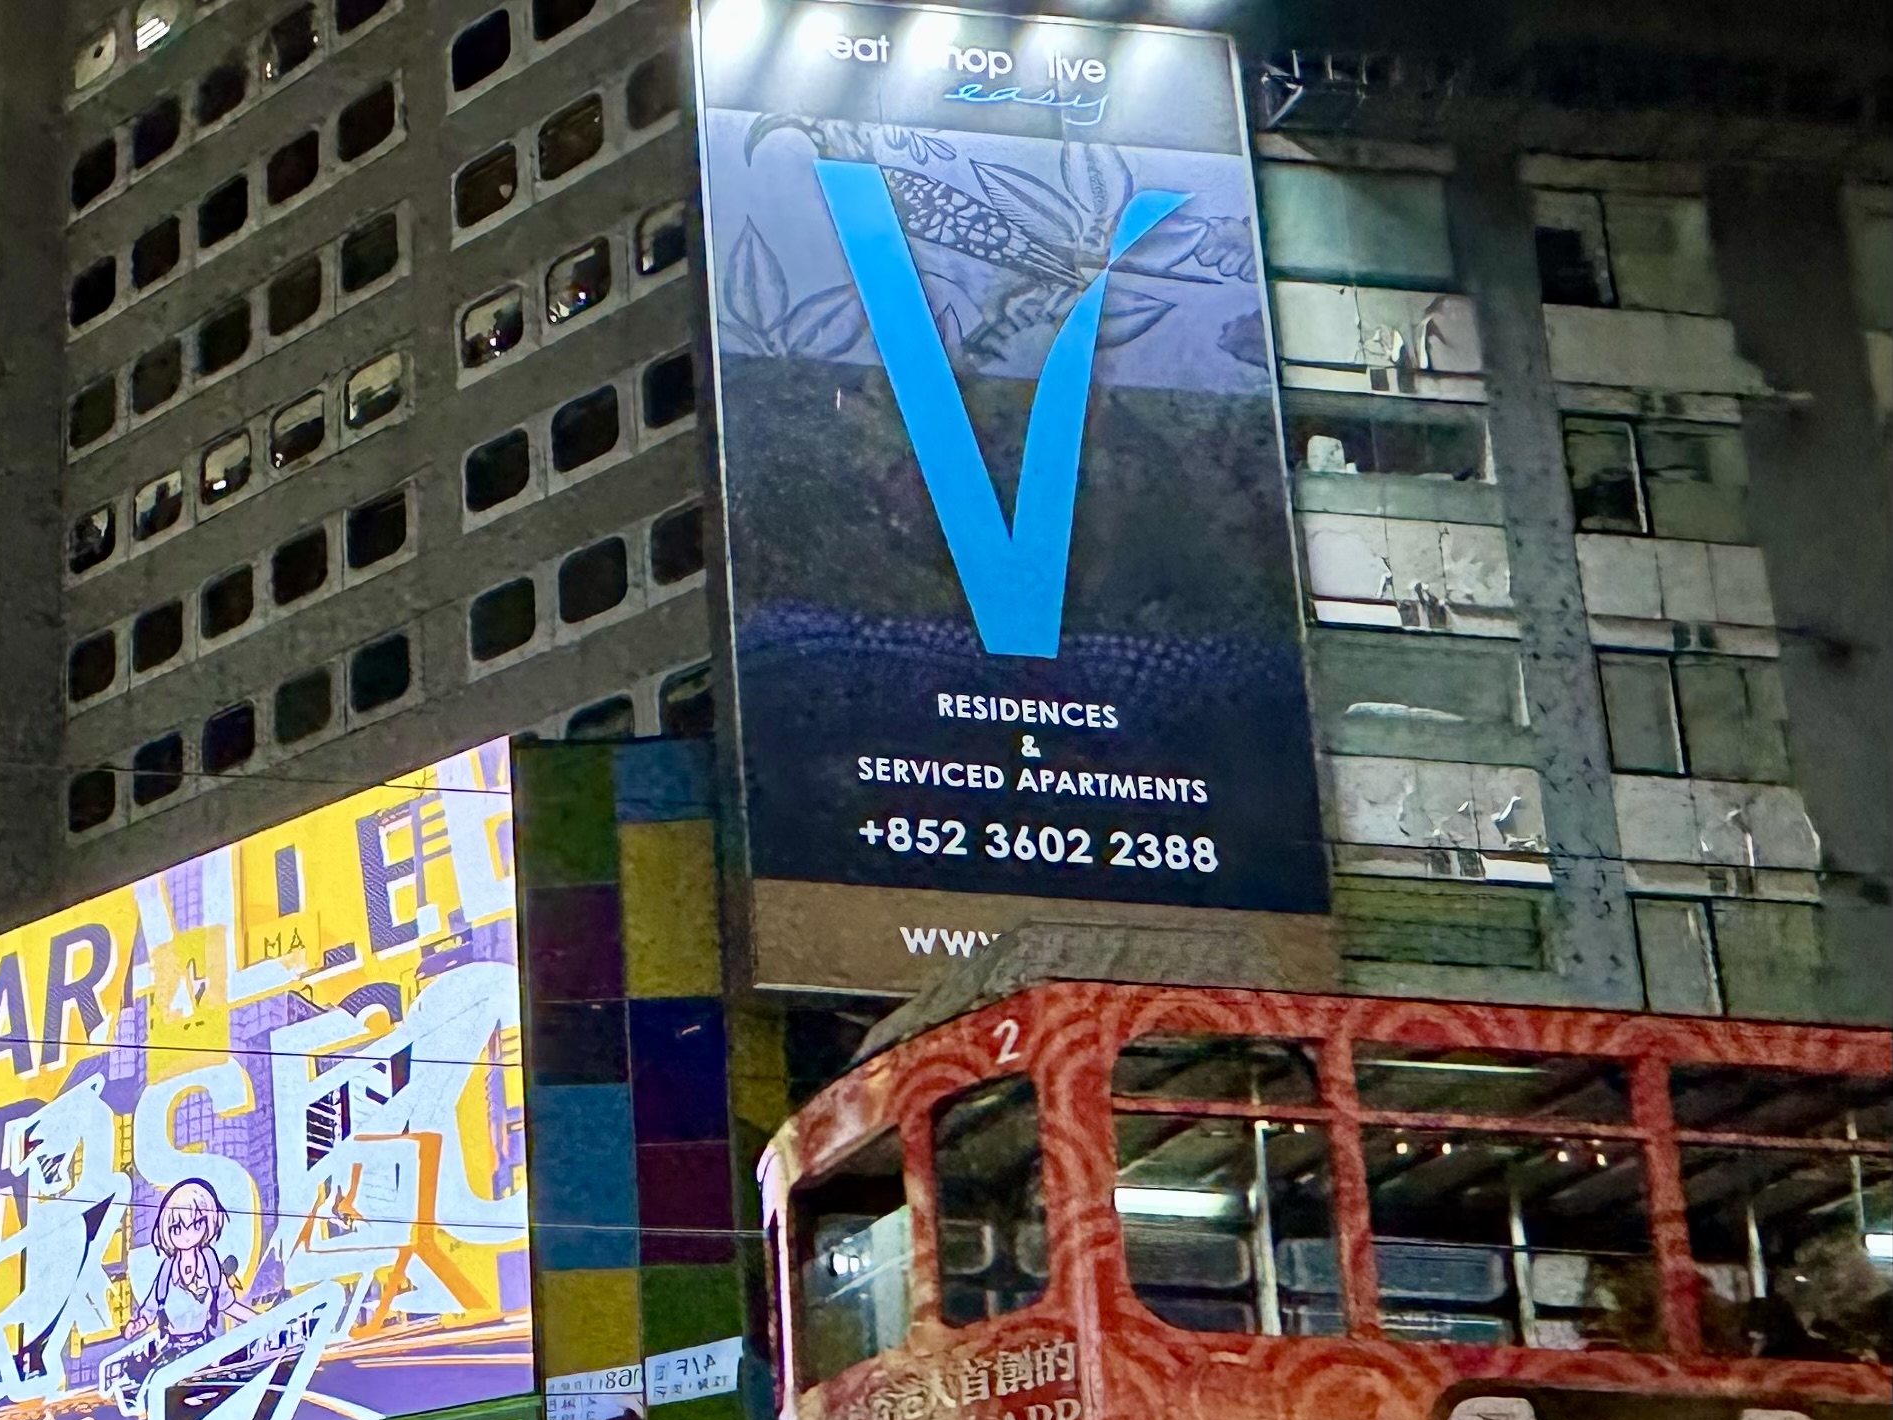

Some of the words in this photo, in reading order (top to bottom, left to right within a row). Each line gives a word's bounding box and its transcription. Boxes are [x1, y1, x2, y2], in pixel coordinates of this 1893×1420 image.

[828, 33, 890, 64] eat
[944, 84, 1109, 126] easy
[937, 693, 1118, 729] RESIDENCES
[1020, 734, 1041, 758] &
[857, 756, 1004, 790] SERVICED
[1016, 767, 1209, 804] APARTMENTS
[859, 817, 967, 857] +852
[985, 822, 1094, 865] 3602
[1109, 830, 1219, 873] 2388
[991, 1018, 1020, 1065] 2
